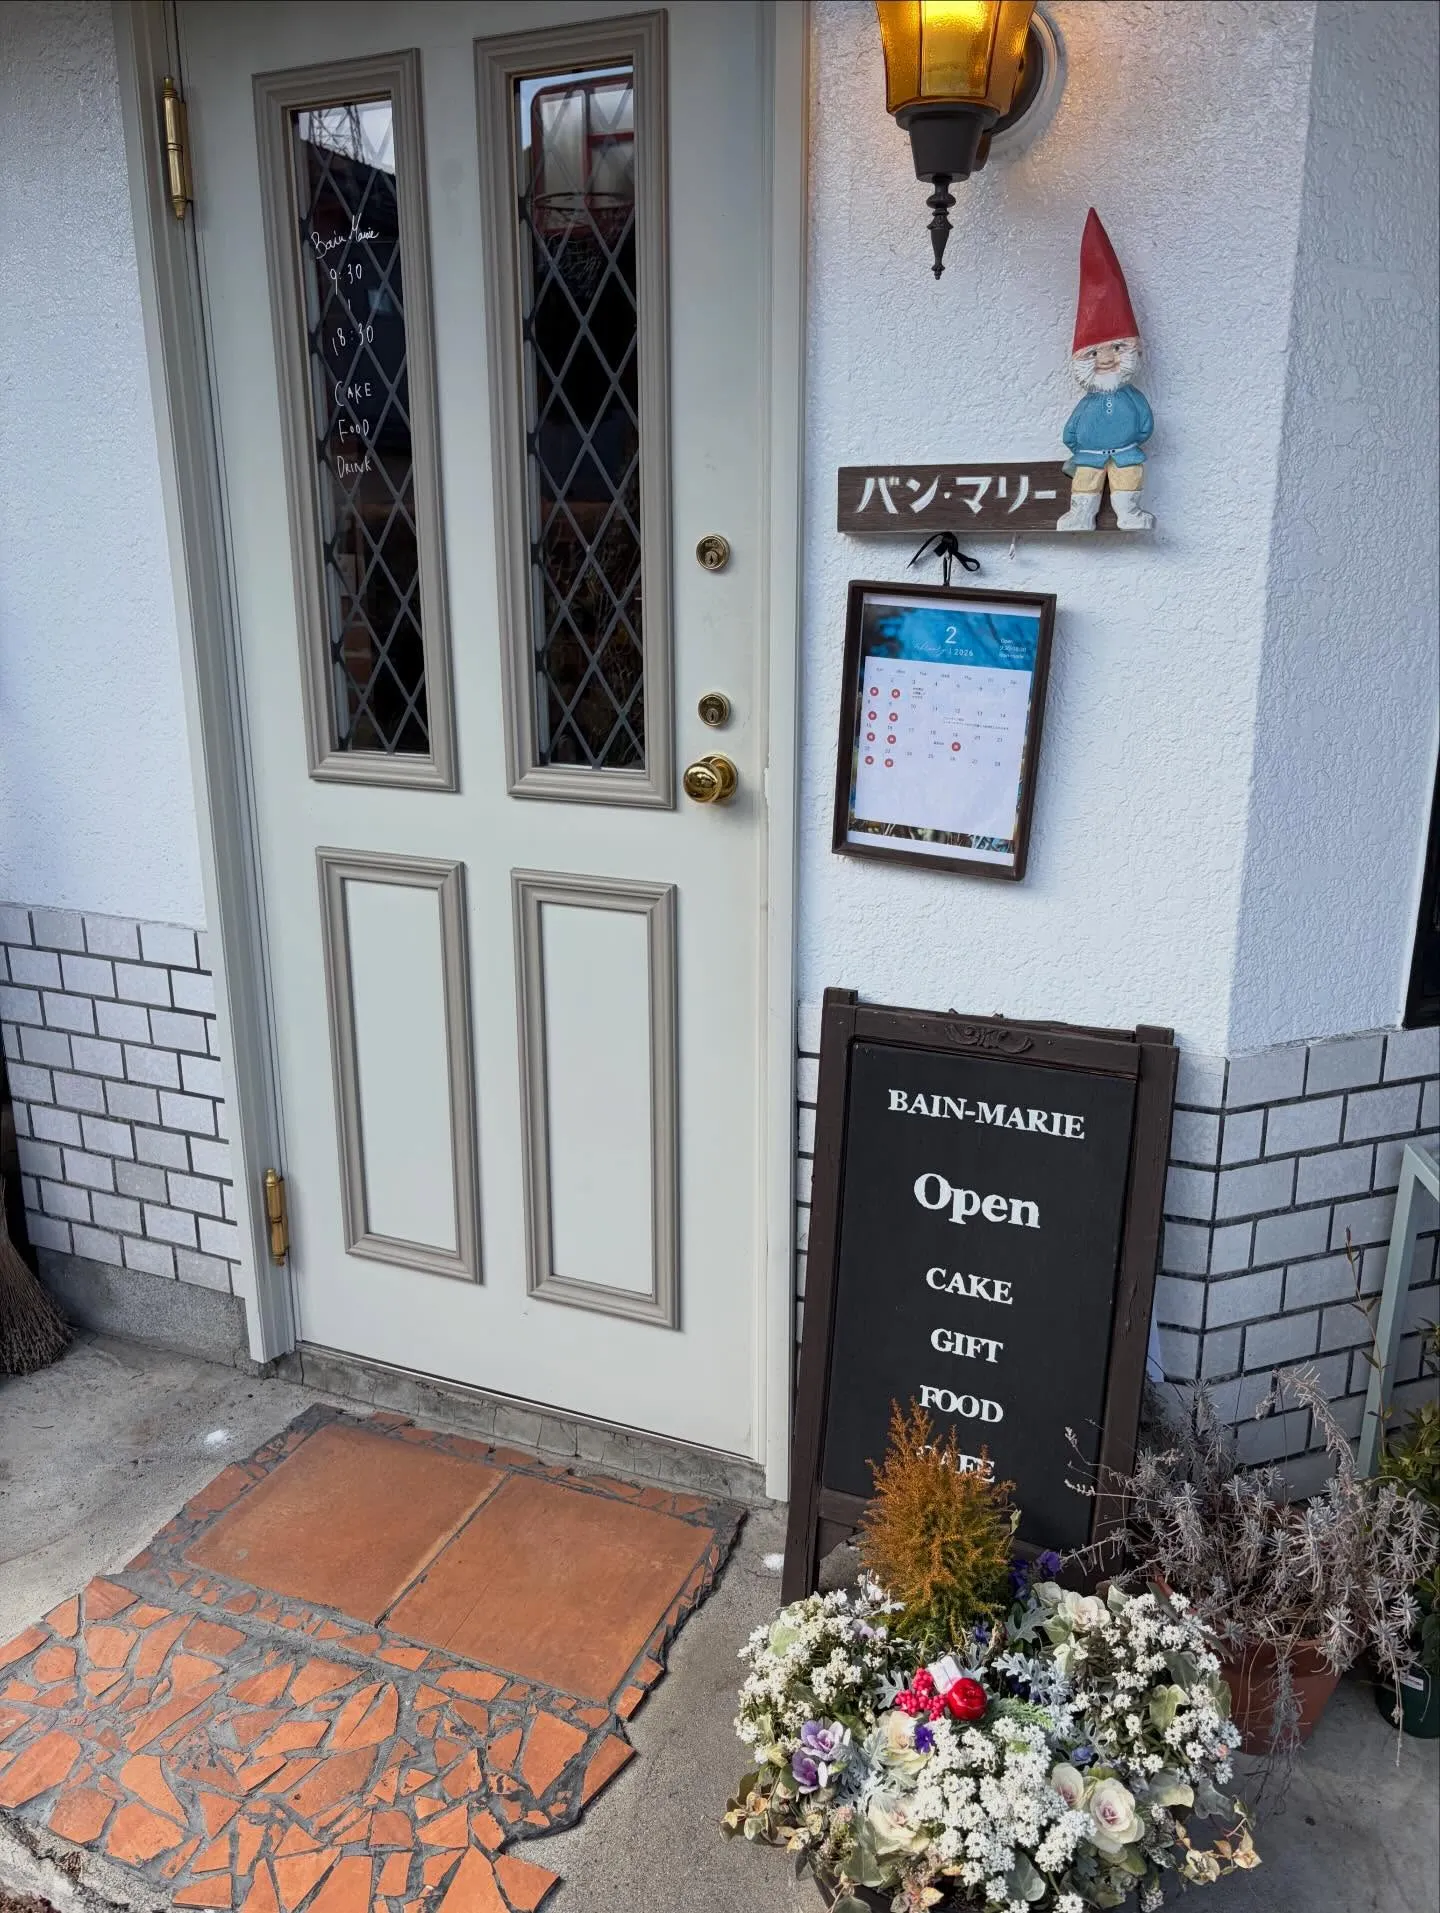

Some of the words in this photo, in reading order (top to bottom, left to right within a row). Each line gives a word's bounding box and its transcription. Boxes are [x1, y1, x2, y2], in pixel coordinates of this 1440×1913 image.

[331, 323, 374, 357] 18:30
[945, 626, 957, 644] 2
[954, 648, 974, 658] 2026
[888, 1088, 1086, 1140] BAIN-MARIE
[913, 1172, 1041, 1229] Open
[925, 1267, 1013, 1305] CAKE
[930, 1328, 1004, 1364] GIFT
[919, 1384, 1004, 1423] FOOD
